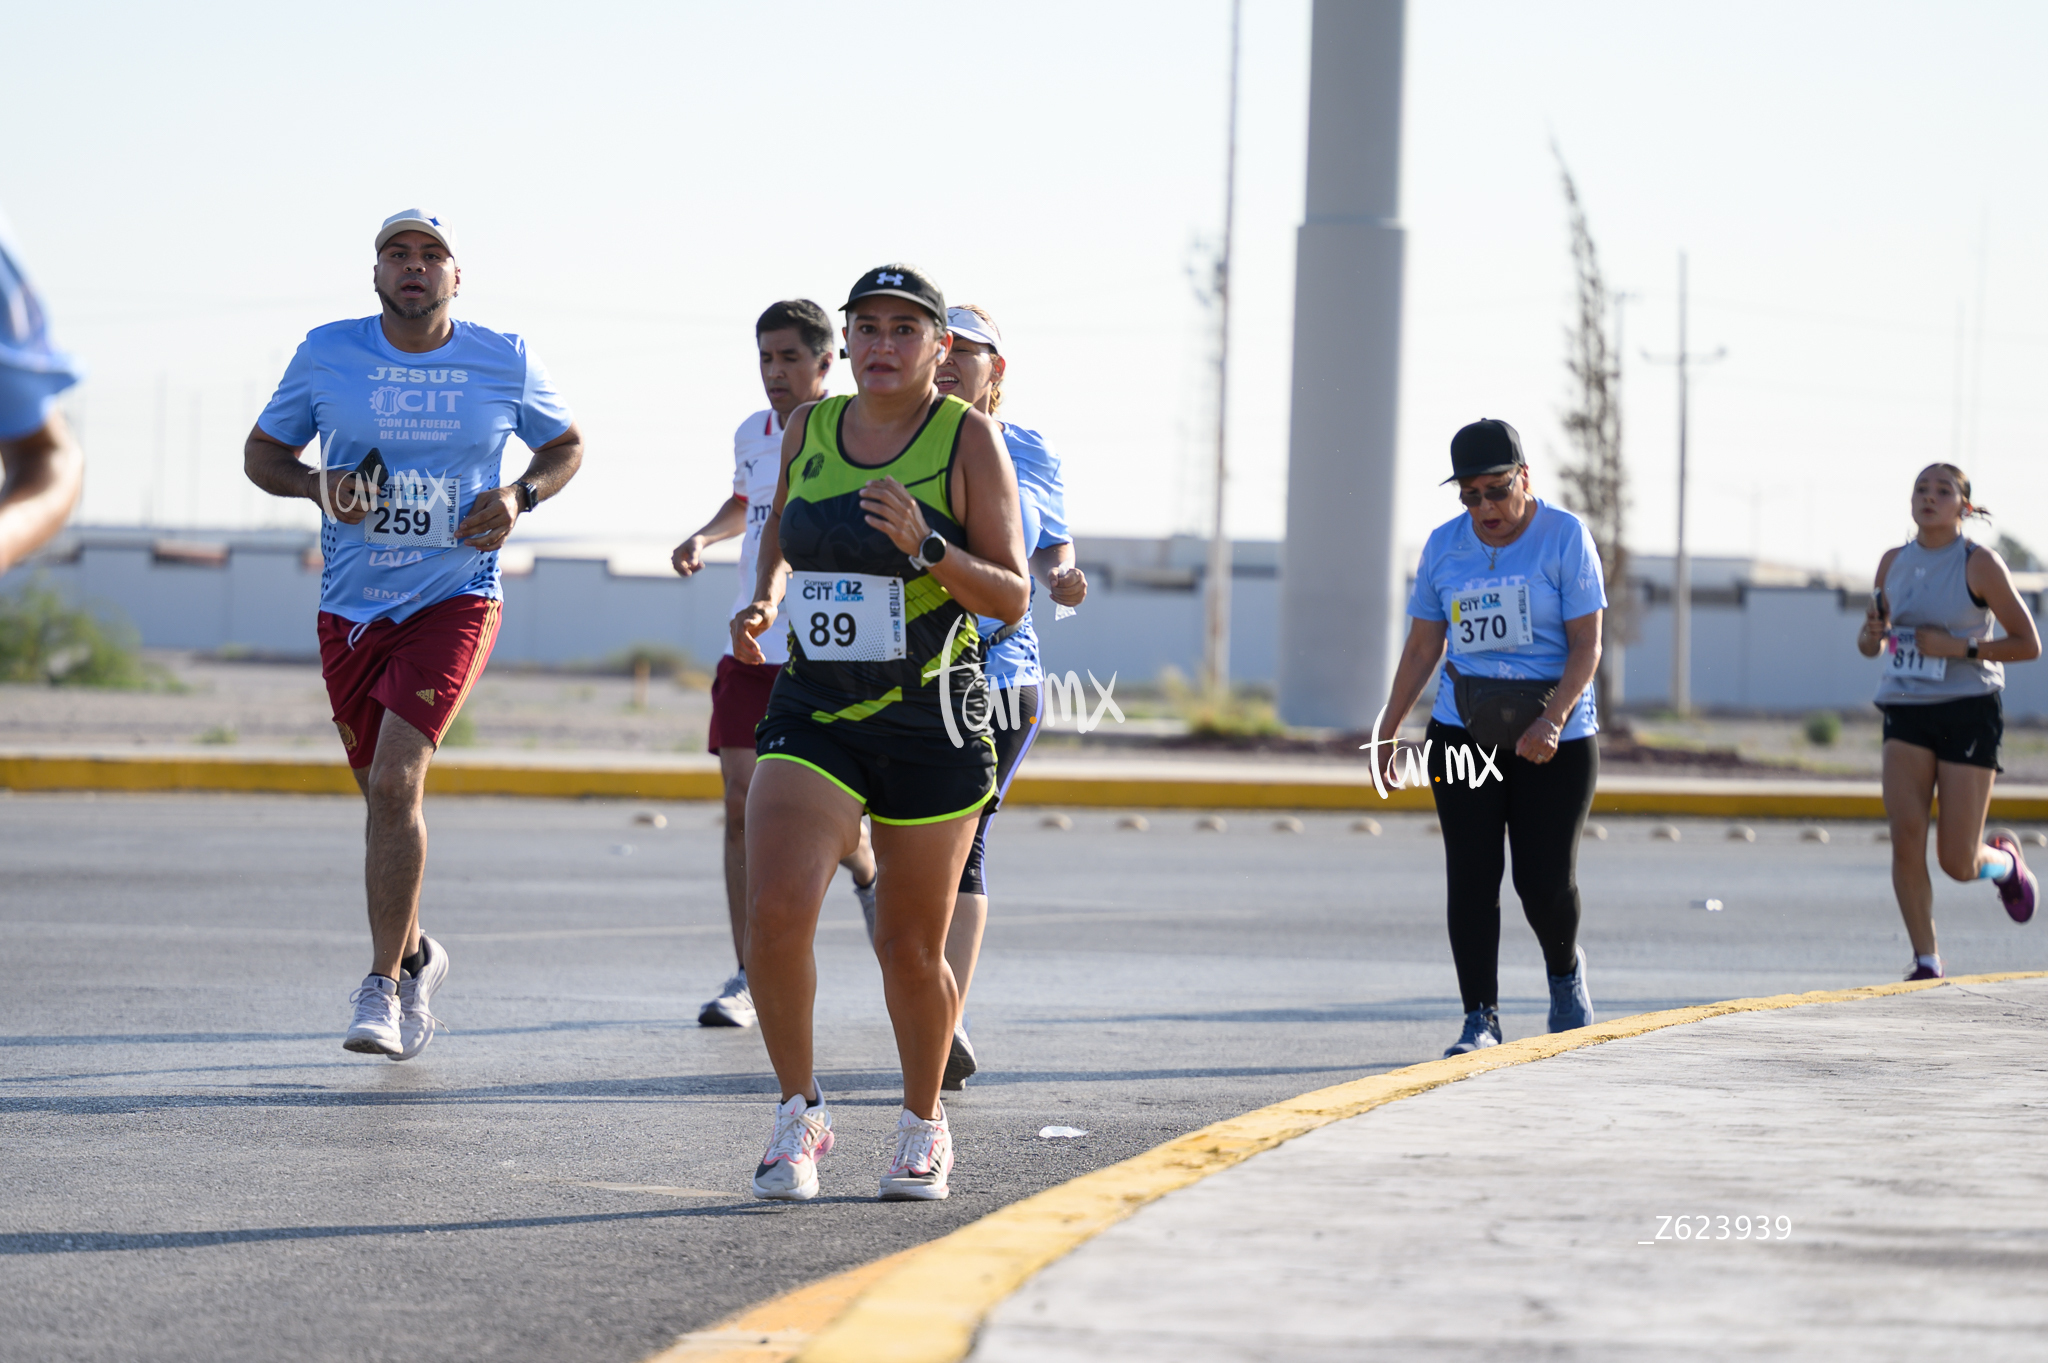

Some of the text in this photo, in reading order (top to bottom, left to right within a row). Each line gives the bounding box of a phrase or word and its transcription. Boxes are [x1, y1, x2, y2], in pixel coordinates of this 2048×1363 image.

[367, 366, 469, 384] JESUS
[397, 389, 465, 413] CIT
[404, 418, 418, 428] LA
[420, 418, 461, 429] FUERZA
[379, 430, 394, 440] DE
[396, 430, 409, 440] LA
[373, 506, 431, 536] 259
[802, 586, 833, 601] CIT
[1459, 599, 1480, 612] CIT
[809, 611, 857, 647] 89
[1459, 614, 1507, 644] 370
[1893, 648, 1924, 671] 811
[416, 690, 435, 706] adidas
